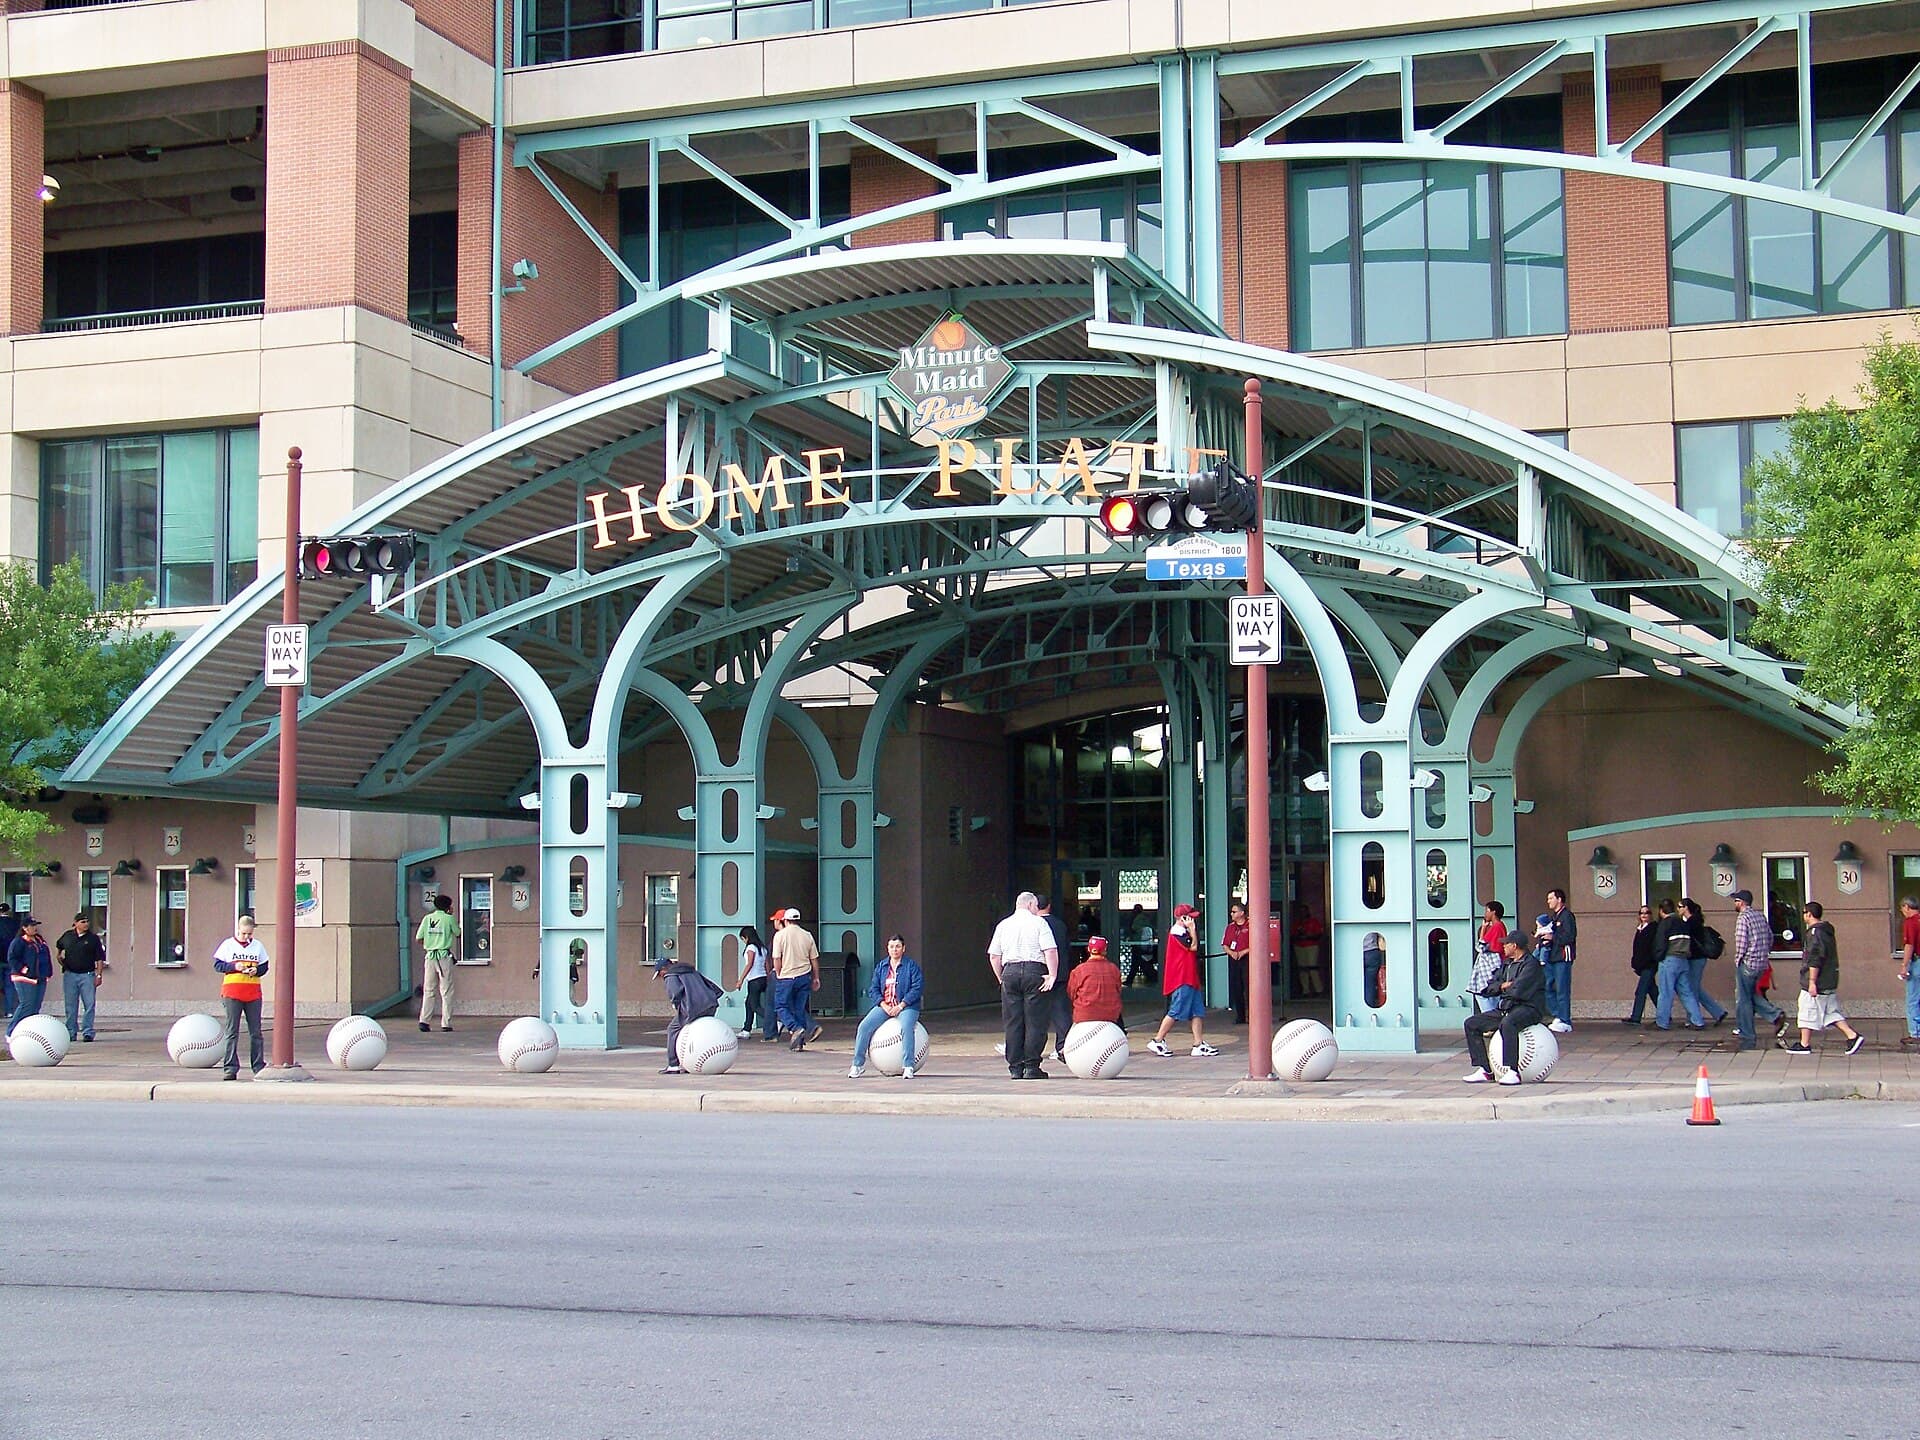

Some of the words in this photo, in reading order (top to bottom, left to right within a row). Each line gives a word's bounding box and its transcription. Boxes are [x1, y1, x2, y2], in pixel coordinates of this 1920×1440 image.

[899, 345, 1000, 370] Minute
[914, 366, 986, 394] Maid
[914, 395, 988, 430] Park
[585, 447, 850, 549] HOME
[1174, 539, 1194, 550] GEORGE
[1200, 538, 1218, 548] BROWN
[1221, 546, 1242, 555] 1800
[1166, 560, 1226, 577] Texas
[1237, 602, 1274, 617] ONE
[1236, 621, 1274, 636] WAY
[272, 631, 302, 644] ONE
[271, 647, 302, 660] WAY
[89, 837, 101, 849] 22
[167, 835, 179, 847] 23
[1597, 875, 1614, 888] 28
[1717, 873, 1733, 887] 29
[1841, 871, 1858, 885] 30
[424, 891, 436, 902] 25
[514, 890, 527, 902] 26
[232, 952, 258, 961] Astros
